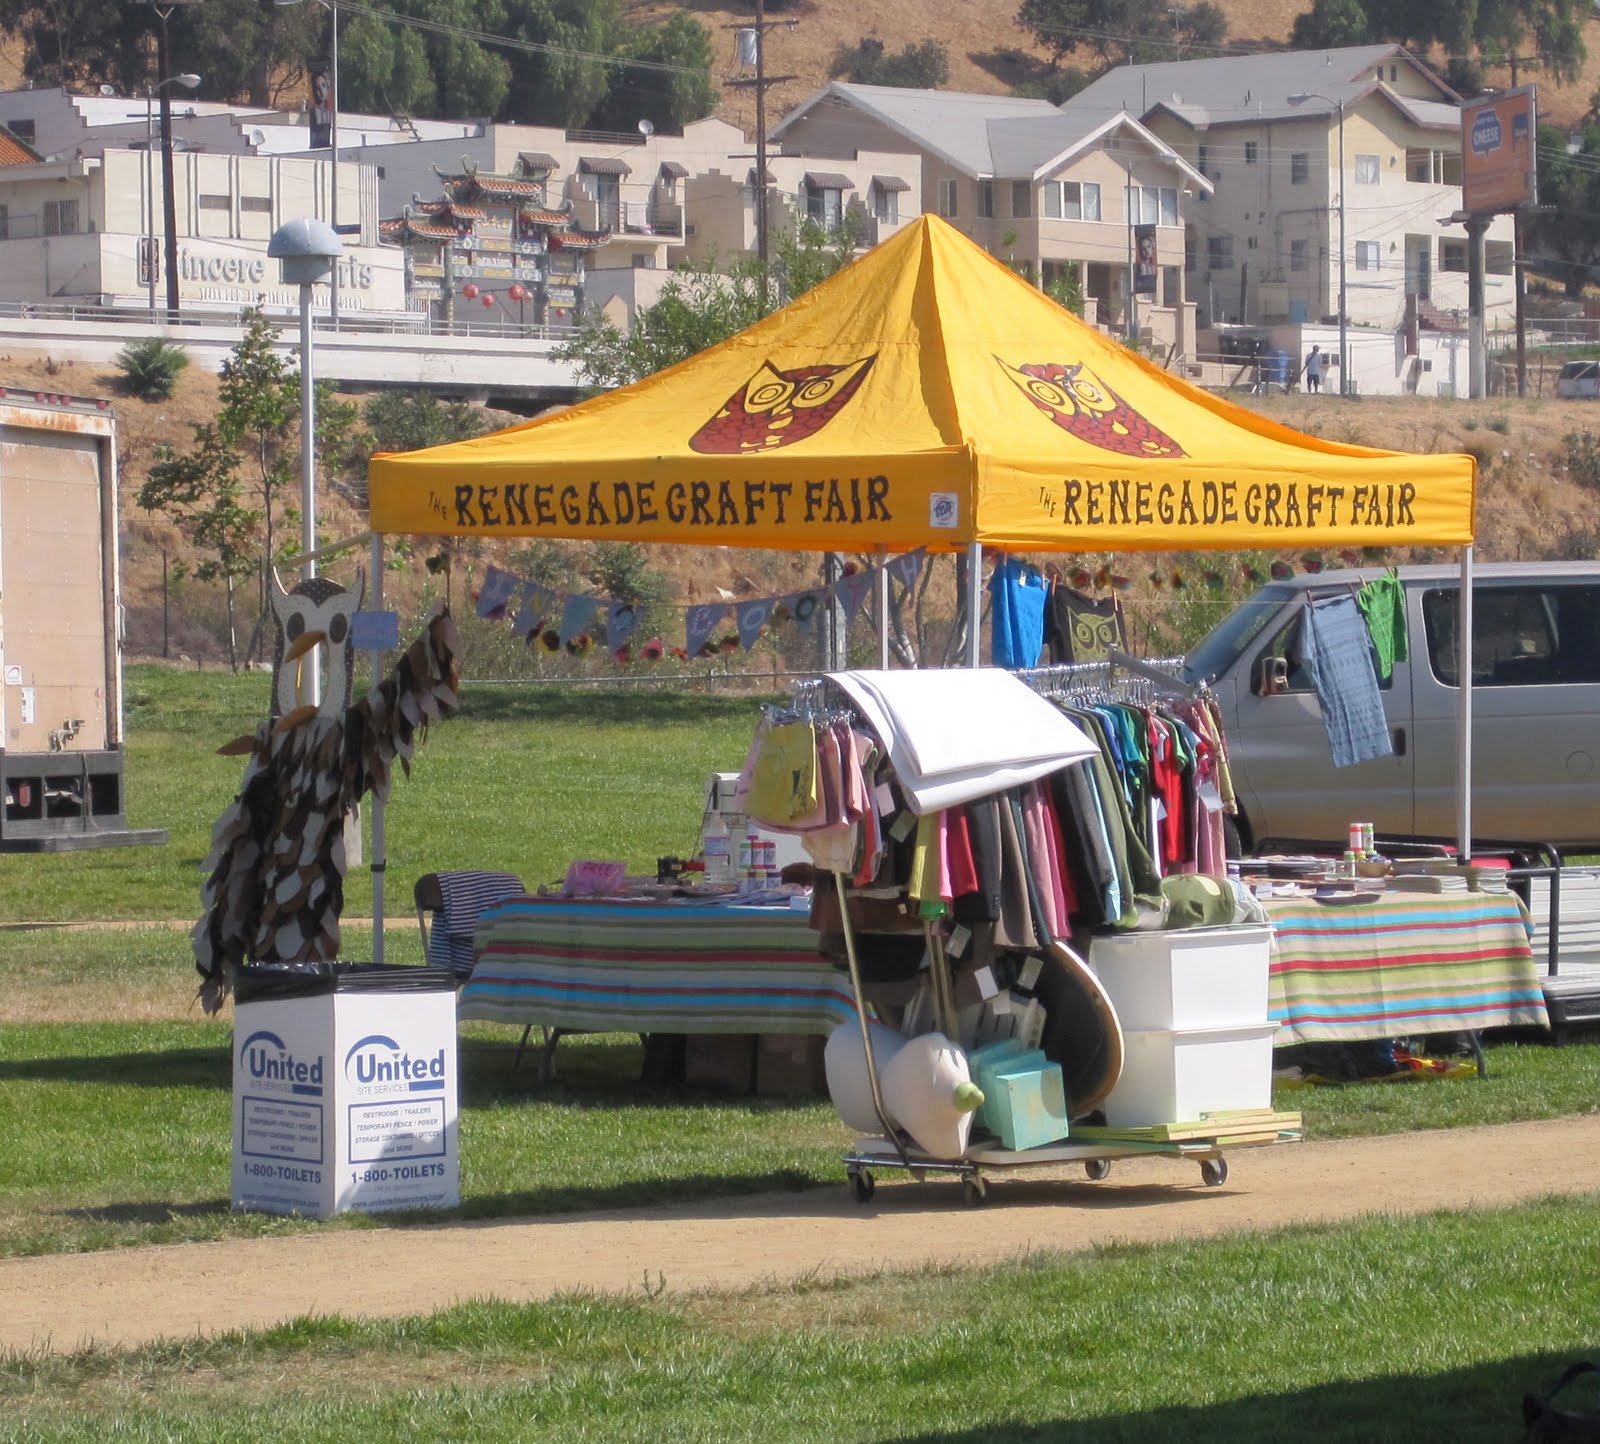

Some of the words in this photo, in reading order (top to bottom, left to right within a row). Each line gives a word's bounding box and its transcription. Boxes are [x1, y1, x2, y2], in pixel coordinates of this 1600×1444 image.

[164, 243, 265, 284] incere
[428, 491, 448, 520] THE
[455, 480, 658, 527] RENEGADE
[666, 480, 793, 526] CRAFT
[804, 475, 892, 525] FAIR
[1039, 486, 1057, 518] THE
[1063, 479, 1238, 526] RENEGADE
[1245, 482, 1345, 528] CRAFT
[1350, 482, 1416, 528] FAIR
[250, 1048, 323, 1085] United
[356, 1049, 445, 1083] United
[357, 1086, 372, 1096] SITE
[374, 1083, 408, 1094] SERVICES
[363, 1109, 399, 1119] RESTROOMS
[404, 1107, 431, 1115] TRAILERS
[357, 1122, 392, 1132] TEMPORARY
[393, 1120, 412, 1129] FENCE
[418, 1118, 438, 1126] POWER
[355, 1134, 380, 1144] STORAGE
[243, 1163, 322, 1184] 1-800-TOILETS
[351, 1164, 445, 1184] 1-800-TOILETS
